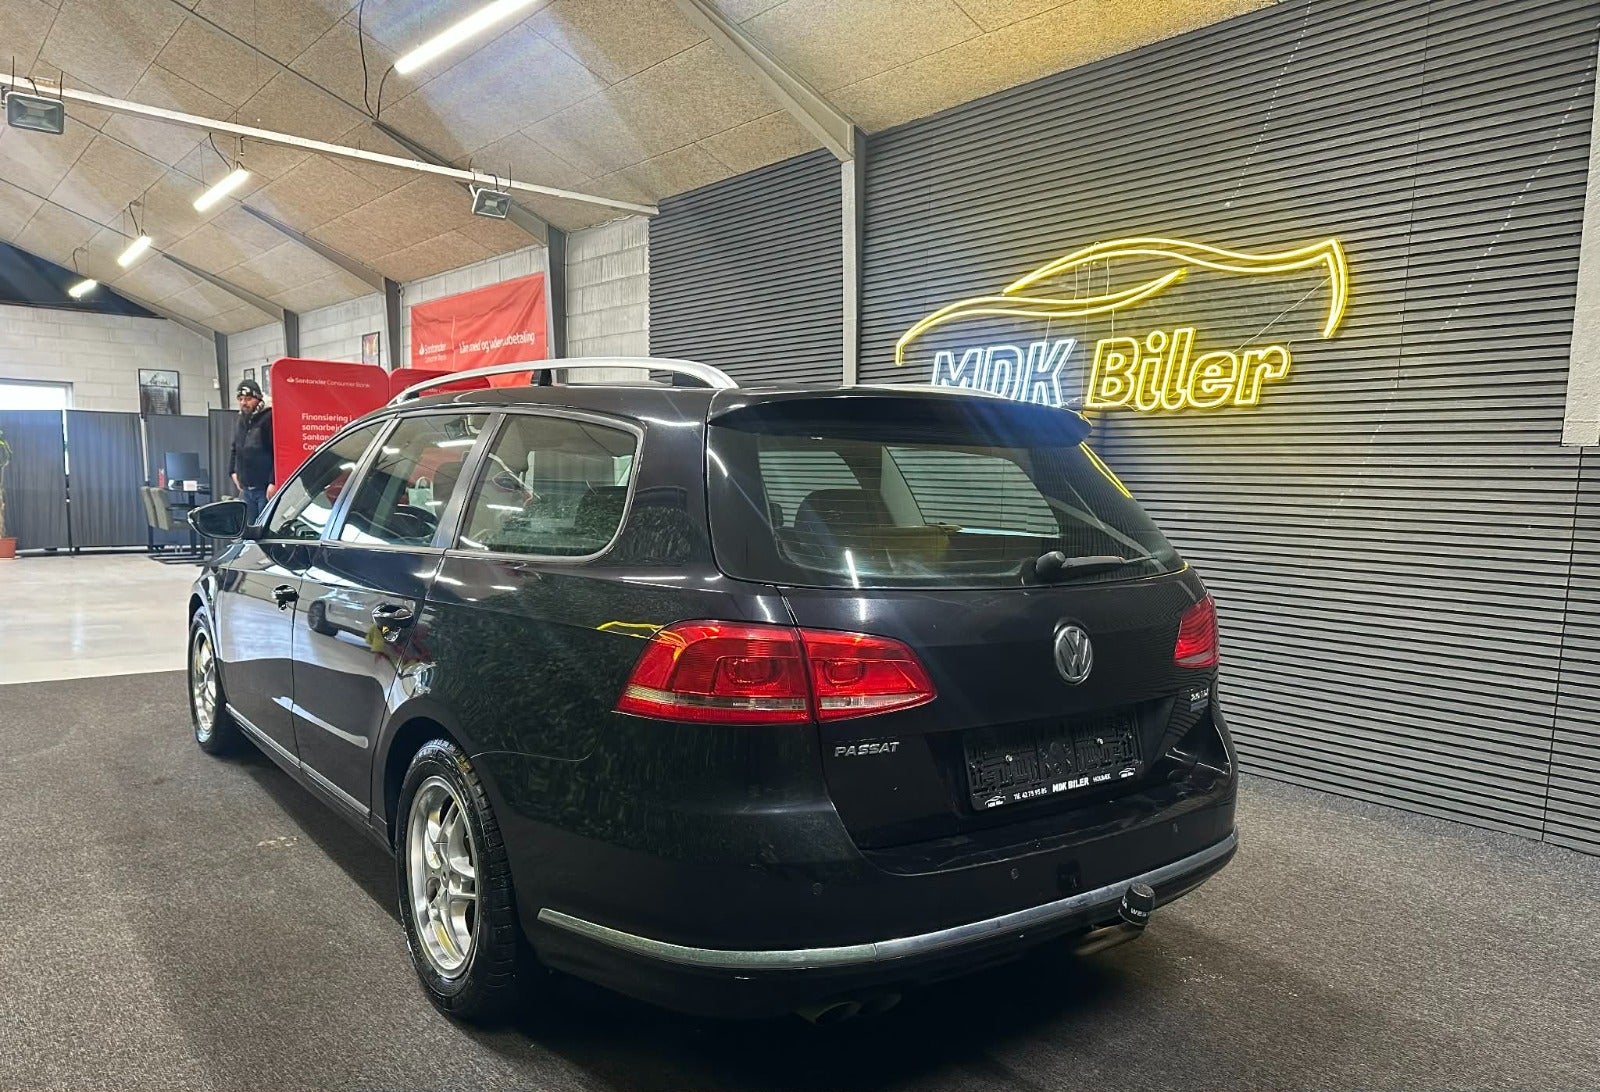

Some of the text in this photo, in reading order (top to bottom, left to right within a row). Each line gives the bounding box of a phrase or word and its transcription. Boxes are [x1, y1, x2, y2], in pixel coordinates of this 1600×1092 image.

[931, 327, 1292, 412] MDK Biler
[295, 377, 326, 386] Santander
[326, 379, 354, 388] Consumer
[301, 412, 349, 424] Finansiering
[302, 433, 330, 442] Santan
[834, 741, 900, 758] PASSAT
[1052, 782, 1067, 793] MDK
[1068, 776, 1089, 790] BILER
